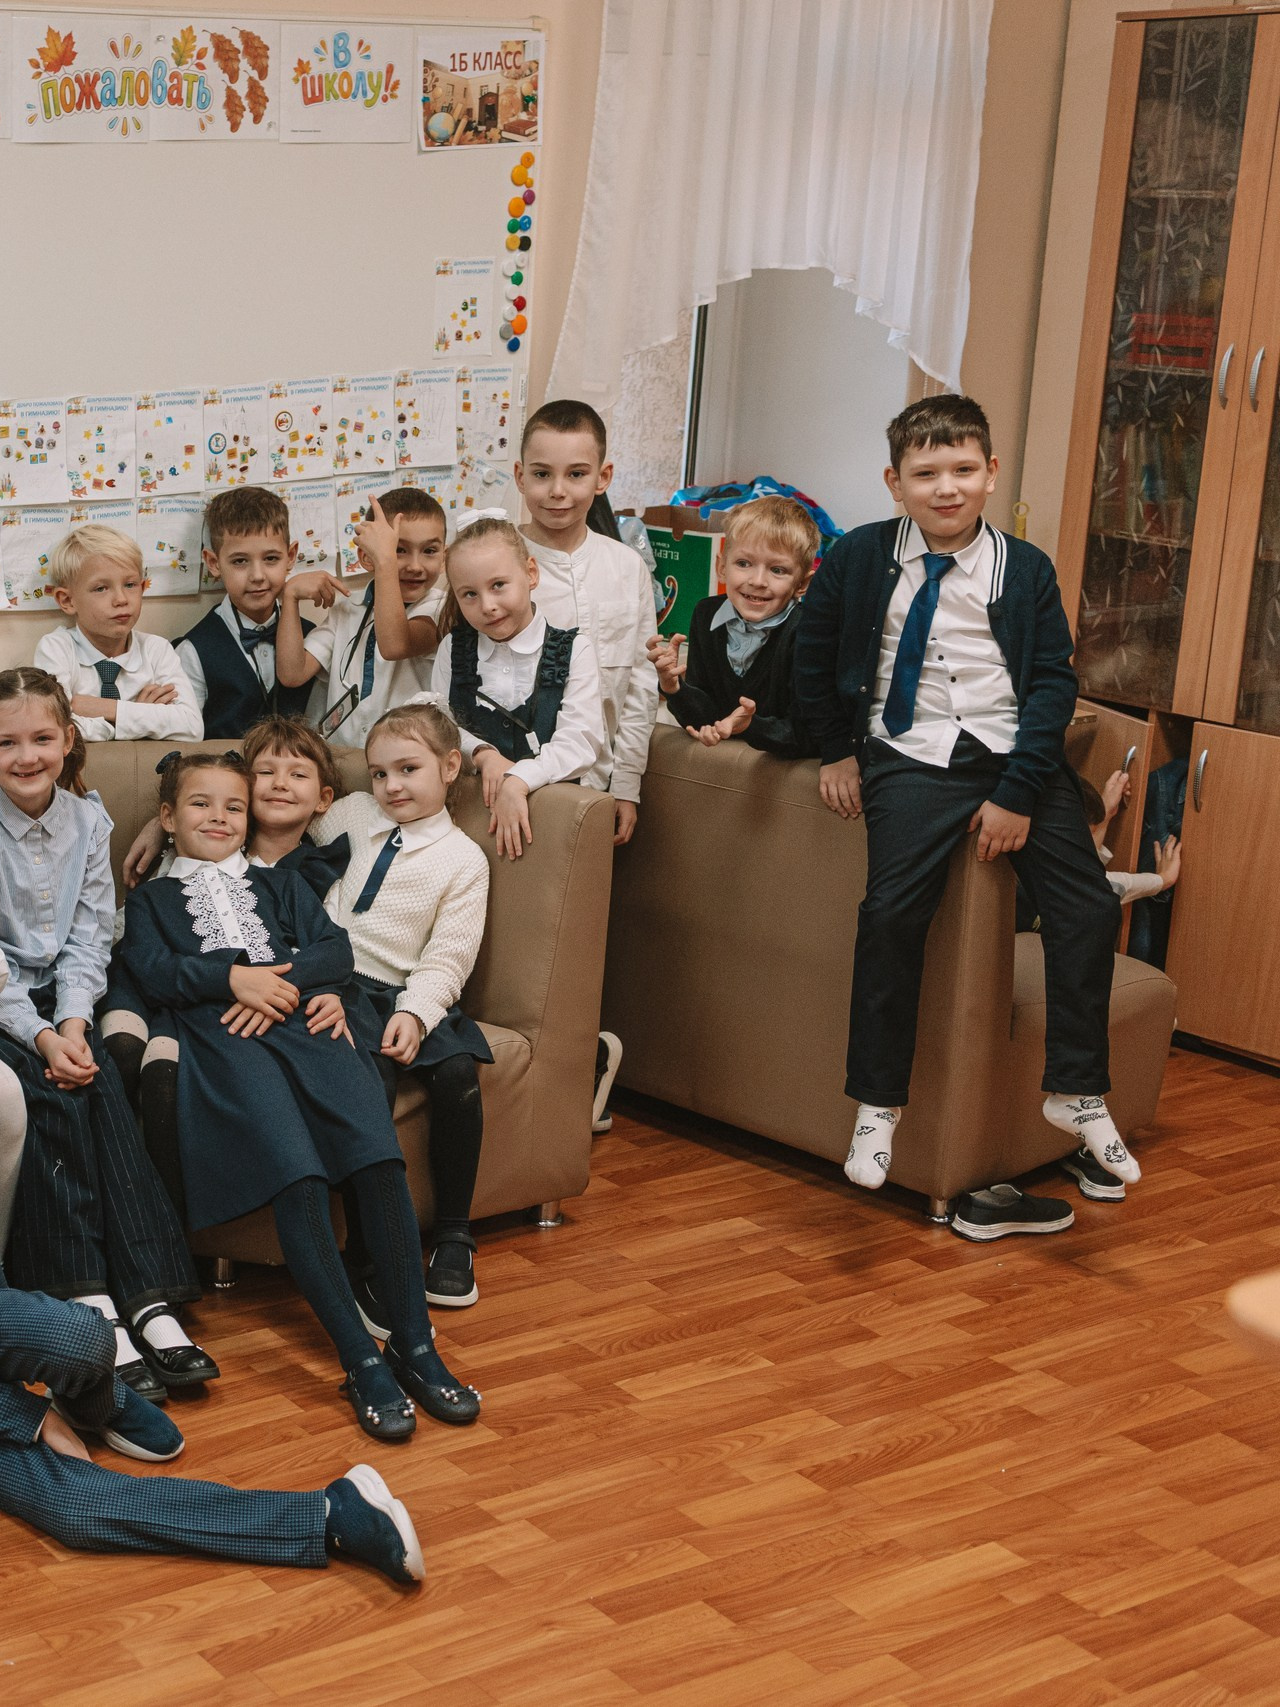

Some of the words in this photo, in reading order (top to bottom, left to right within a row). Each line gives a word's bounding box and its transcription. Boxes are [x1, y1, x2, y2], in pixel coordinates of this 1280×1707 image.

[333, 31, 352, 69] В
[449, 52, 468, 72] 1Б
[473, 50, 522, 72] КЛАСС
[39, 57, 213, 121] пожаловать
[301, 63, 395, 109] школу!
